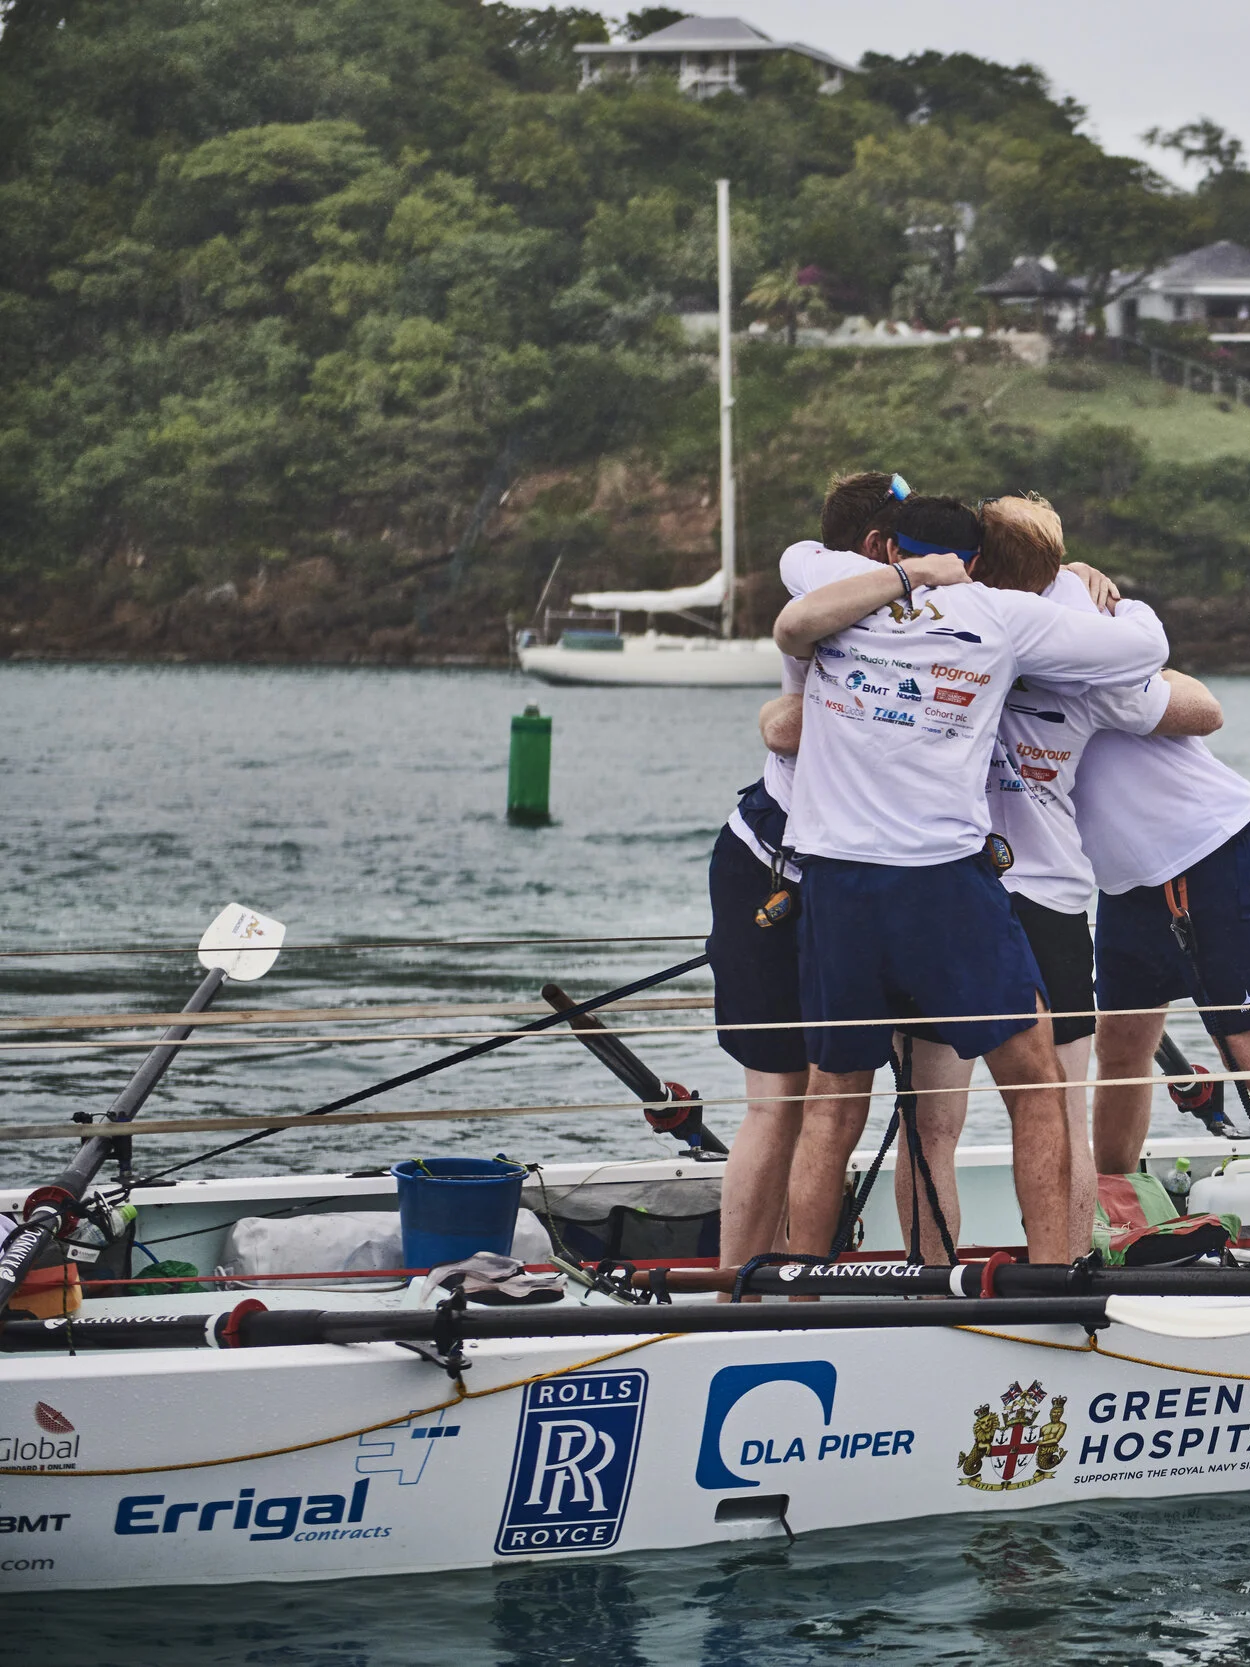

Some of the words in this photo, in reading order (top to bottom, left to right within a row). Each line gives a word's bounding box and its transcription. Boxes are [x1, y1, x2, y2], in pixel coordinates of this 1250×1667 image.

[892, 660, 913, 670] Nice
[930, 663, 991, 686] tpgroup
[862, 683, 891, 696] BMT
[925, 707, 954, 720] Cohort
[955, 713, 968, 723] plc
[1016, 742, 1071, 763] tpgroup
[991, 759, 1007, 769] MT
[808, 1264, 926, 1277] RANNOCH
[537, 1380, 634, 1405] ROLLS
[739, 1438, 806, 1467] DLA
[818, 1429, 916, 1462] PIPER
[47, 1463, 76, 1471] ONLINE
[1073, 1470, 1144, 1484] SUPPORTING
[1147, 1469, 1167, 1478] THE
[1170, 1464, 1205, 1476] ROYAL
[1208, 1462, 1238, 1473] NAVY
[114, 1477, 370, 1542] Errigal
[0, 1513, 72, 1534] BMT
[293, 1525, 393, 1543] contracts
[509, 1525, 609, 1548] ROYCE
